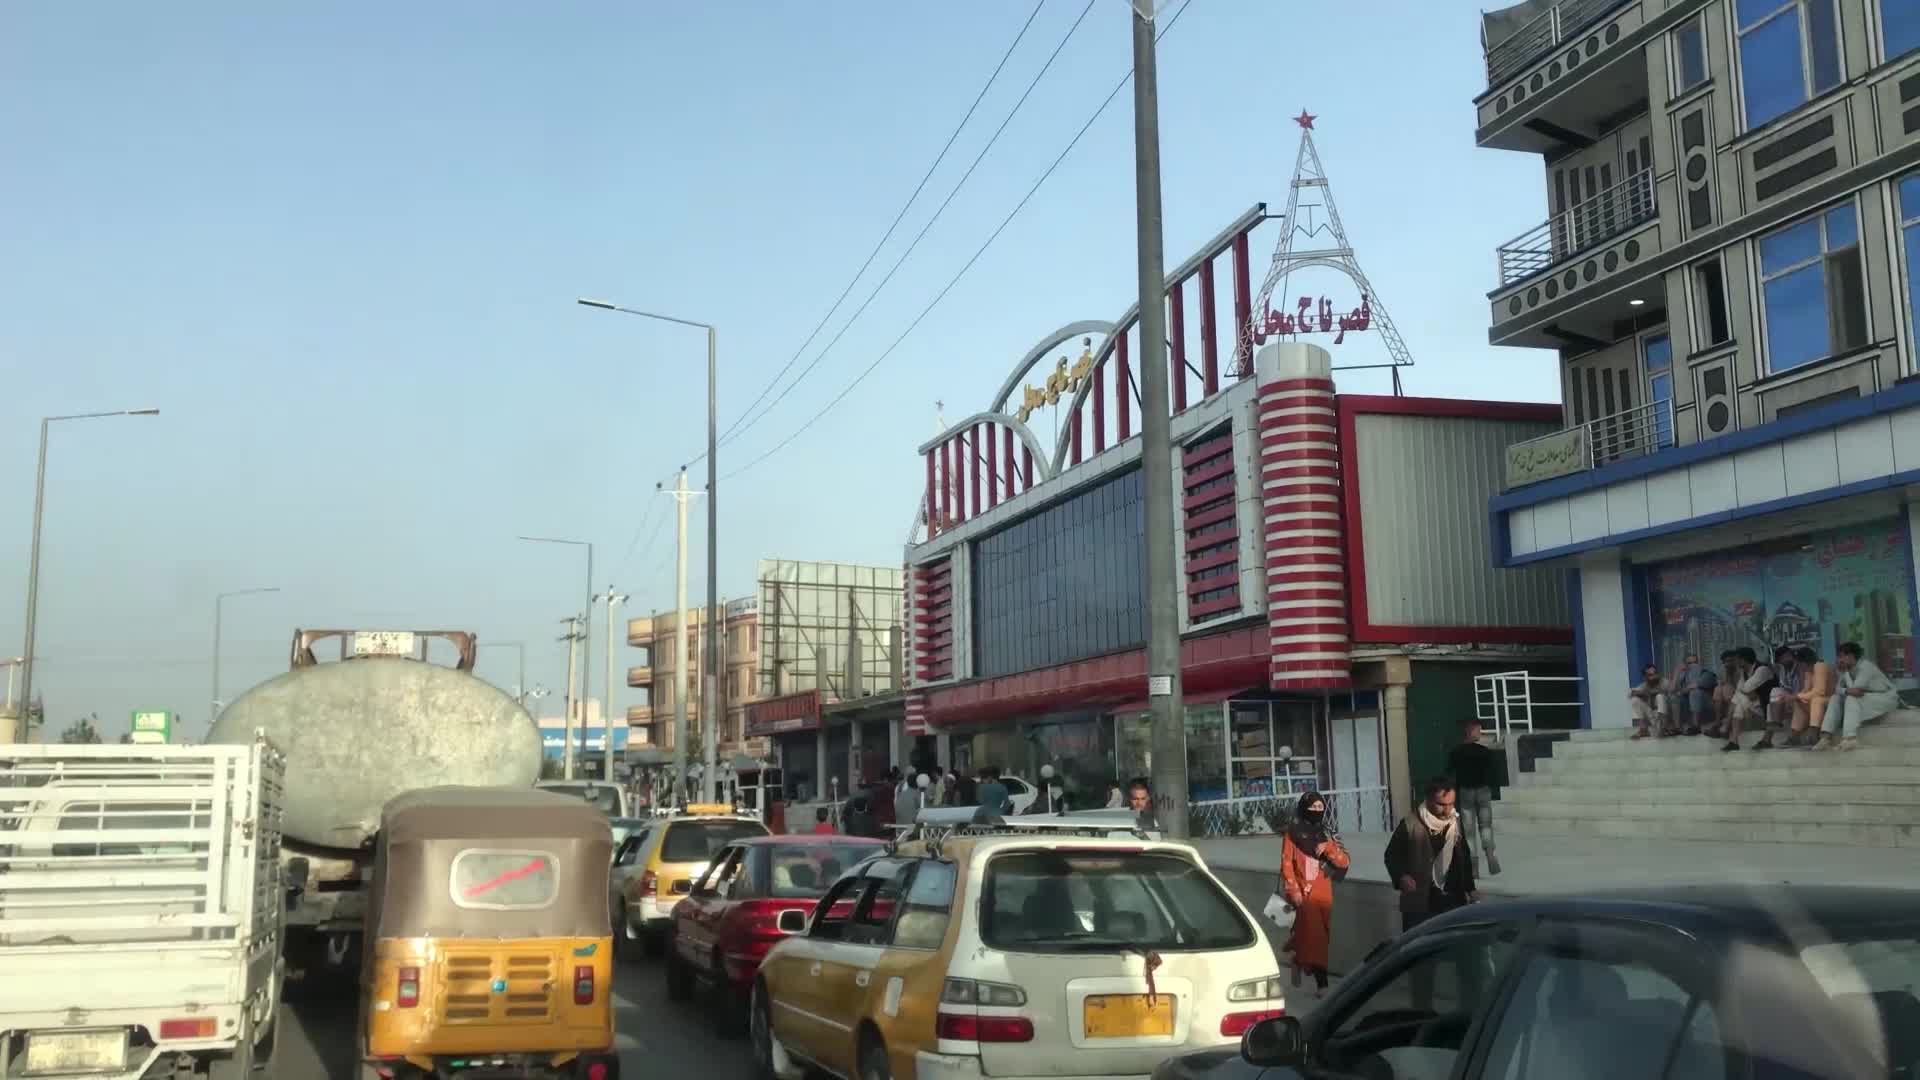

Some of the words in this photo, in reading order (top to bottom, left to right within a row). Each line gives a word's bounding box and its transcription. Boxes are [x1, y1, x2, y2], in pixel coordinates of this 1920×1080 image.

[1253, 295, 1295, 346] محل
[1297, 295, 1332, 333] تاج
[1334, 294, 1370, 344] قصر
